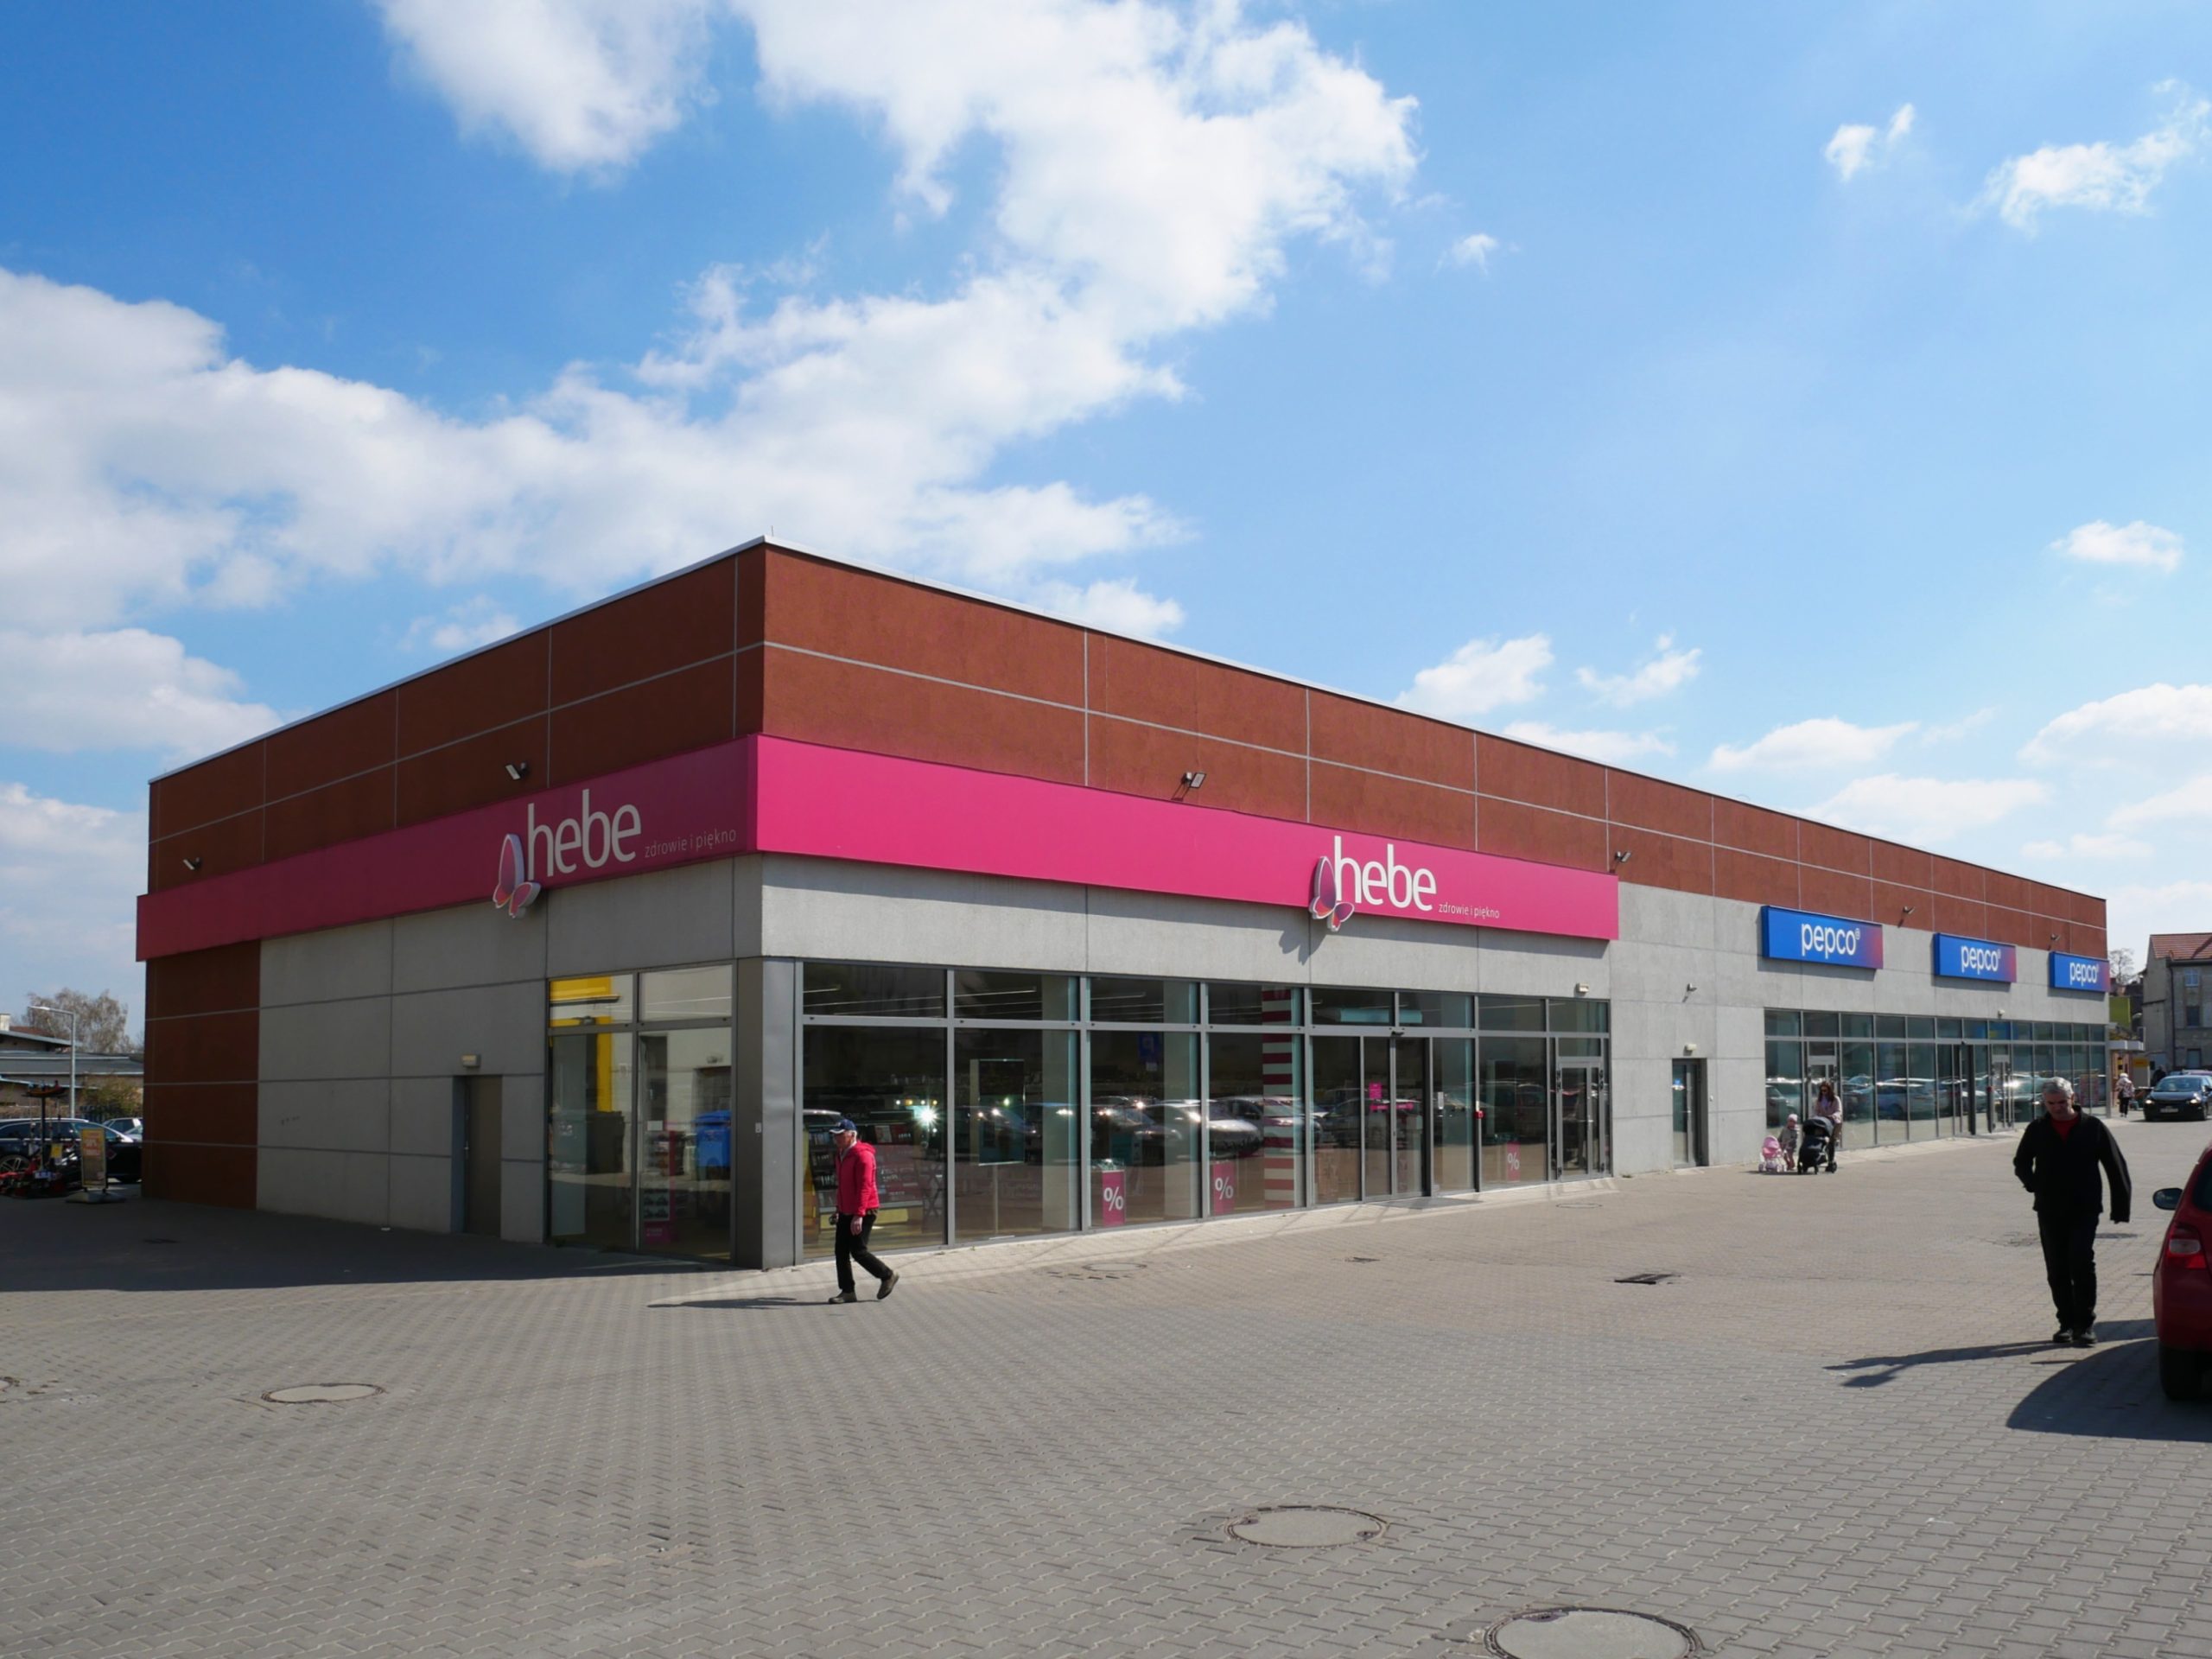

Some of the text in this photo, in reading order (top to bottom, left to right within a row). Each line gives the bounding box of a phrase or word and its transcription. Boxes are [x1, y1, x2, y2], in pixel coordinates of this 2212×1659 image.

[528, 788, 641, 880] hebe
[645, 837, 687, 858] zdrowie
[696, 829, 736, 852] piękno
[1334, 835, 1437, 912] hebe
[1439, 901, 1469, 916] zdrowie
[1474, 906, 1500, 919] piękno
[1801, 924, 1856, 959] pepco
[1961, 945, 1999, 976] pepco
[2069, 962, 2097, 987] pepco
